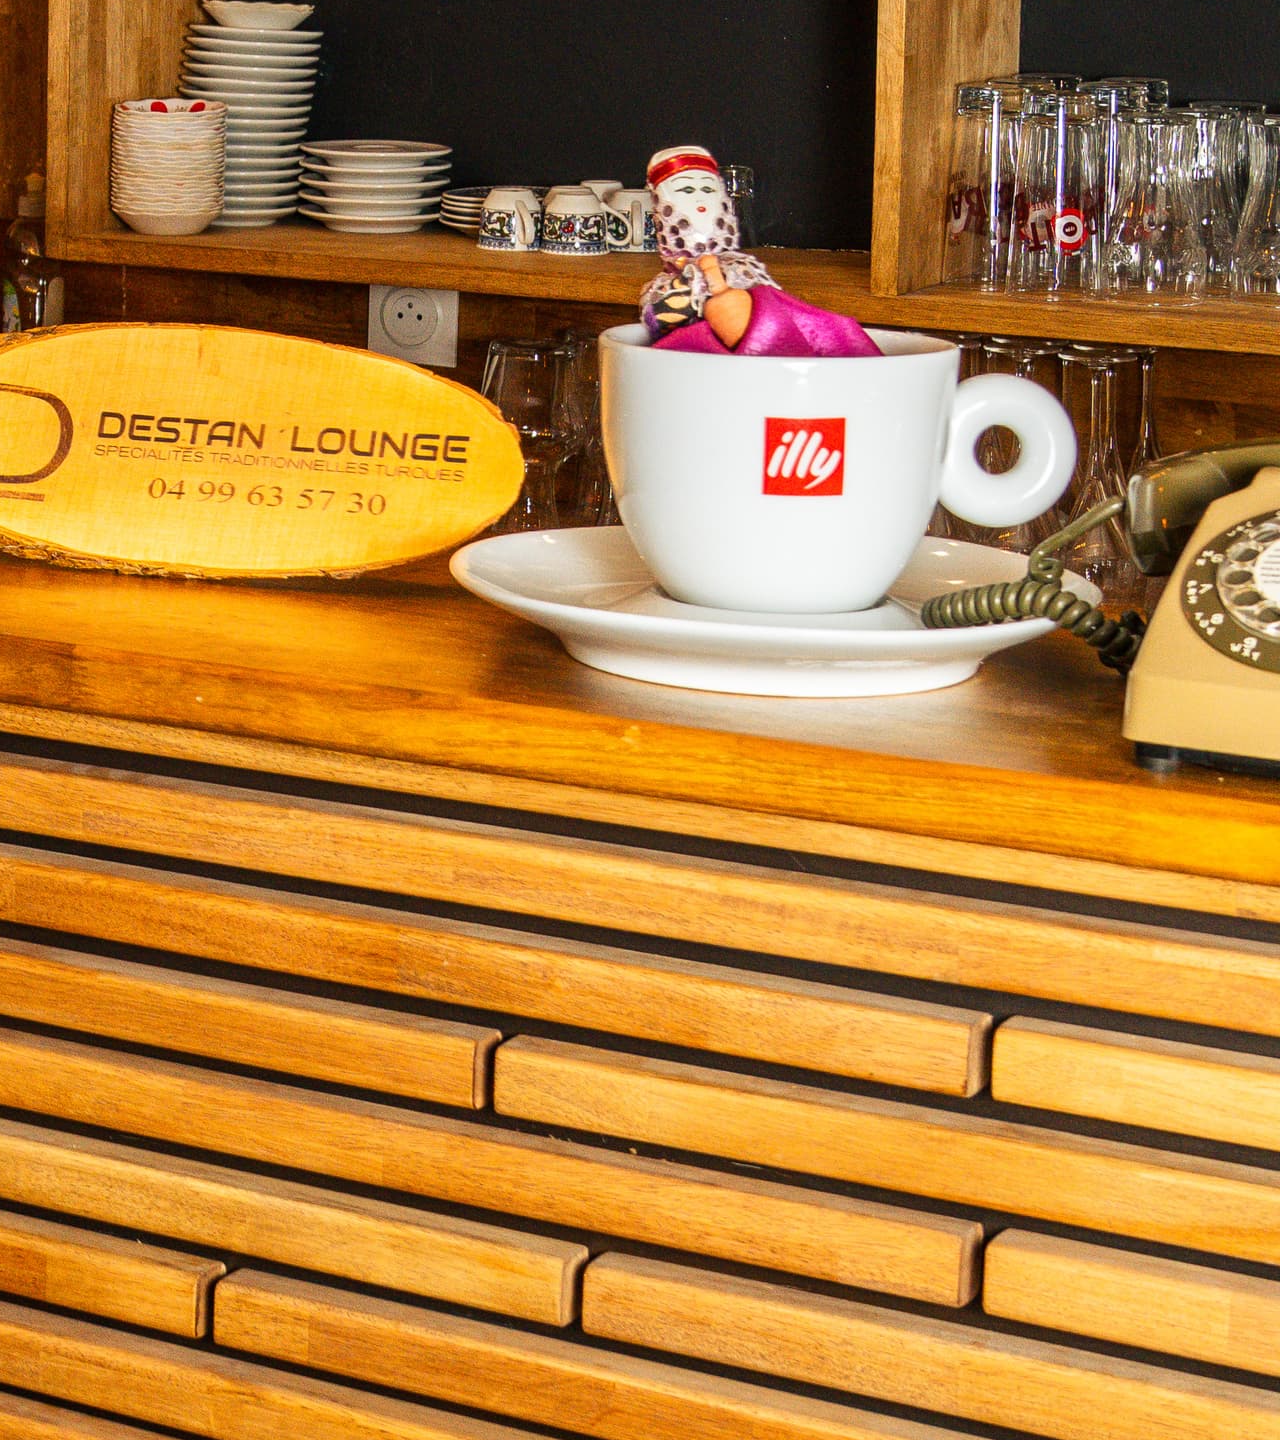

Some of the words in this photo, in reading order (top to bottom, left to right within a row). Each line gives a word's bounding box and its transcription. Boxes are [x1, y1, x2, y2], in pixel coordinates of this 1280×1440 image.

[97, 411, 267, 450] DESTAN
[290, 427, 471, 464] LOUNGE
[209, 452, 369, 475] TRADITIONNELLES
[375, 464, 465, 482] TURQUES
[767, 430, 842, 489] illy
[148, 477, 186, 500] 04
[197, 481, 236, 503] 99
[247, 484, 284, 507] 63
[296, 488, 336, 511] 57
[347, 492, 387, 516] 30
[1199, 583, 1213, 595] 7
